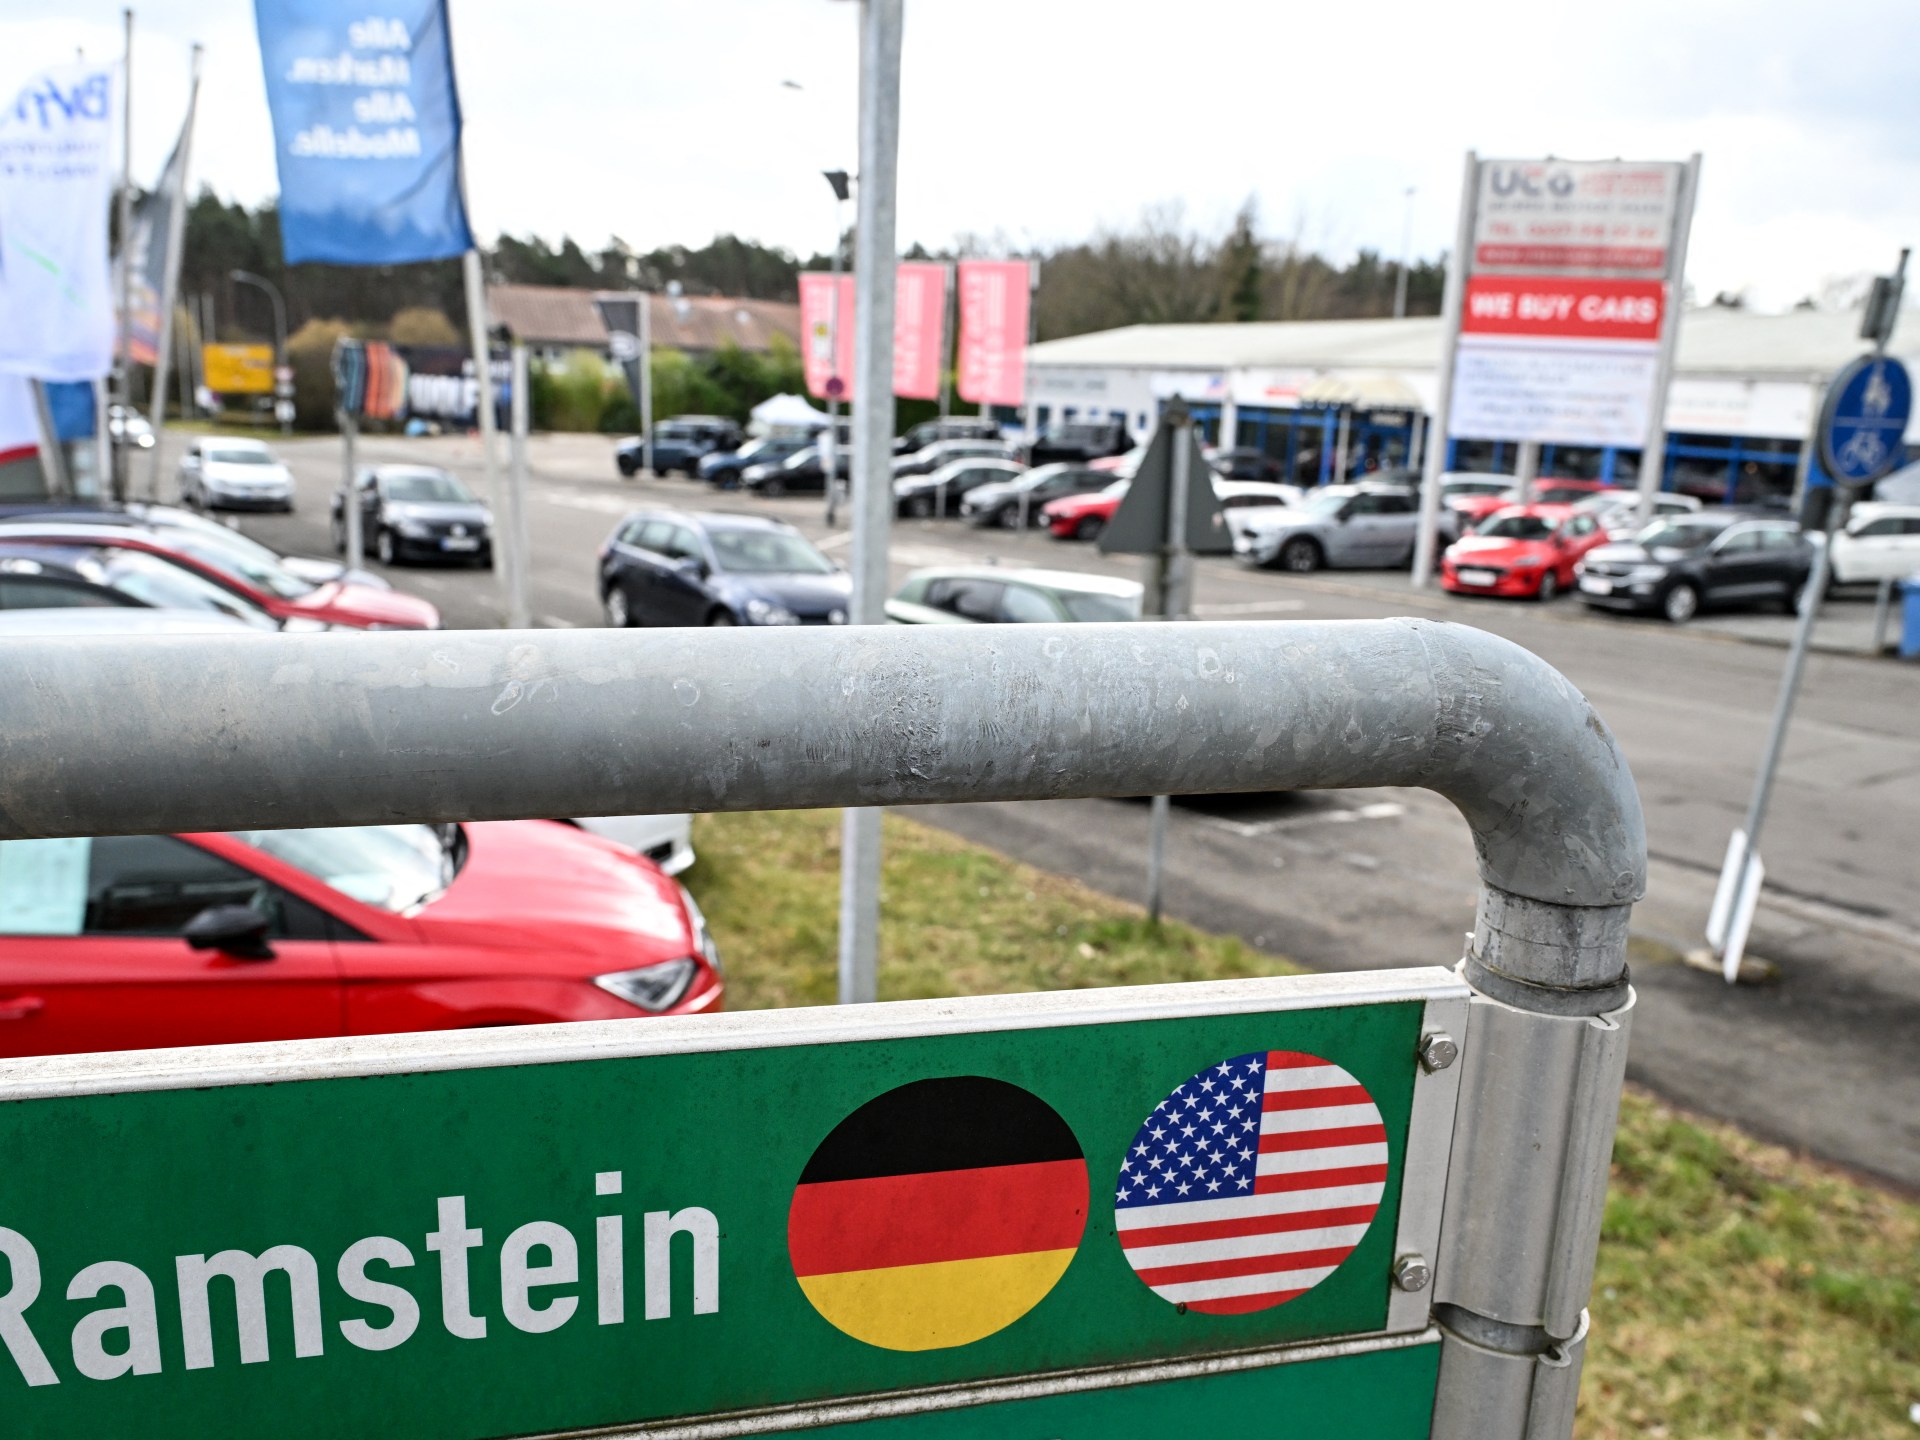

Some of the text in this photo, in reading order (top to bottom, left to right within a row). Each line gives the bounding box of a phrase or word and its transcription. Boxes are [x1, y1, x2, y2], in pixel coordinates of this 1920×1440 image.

[1470, 291, 1658, 324] WE BUY CARS
[0, 1171, 720, 1388] Ramstein
